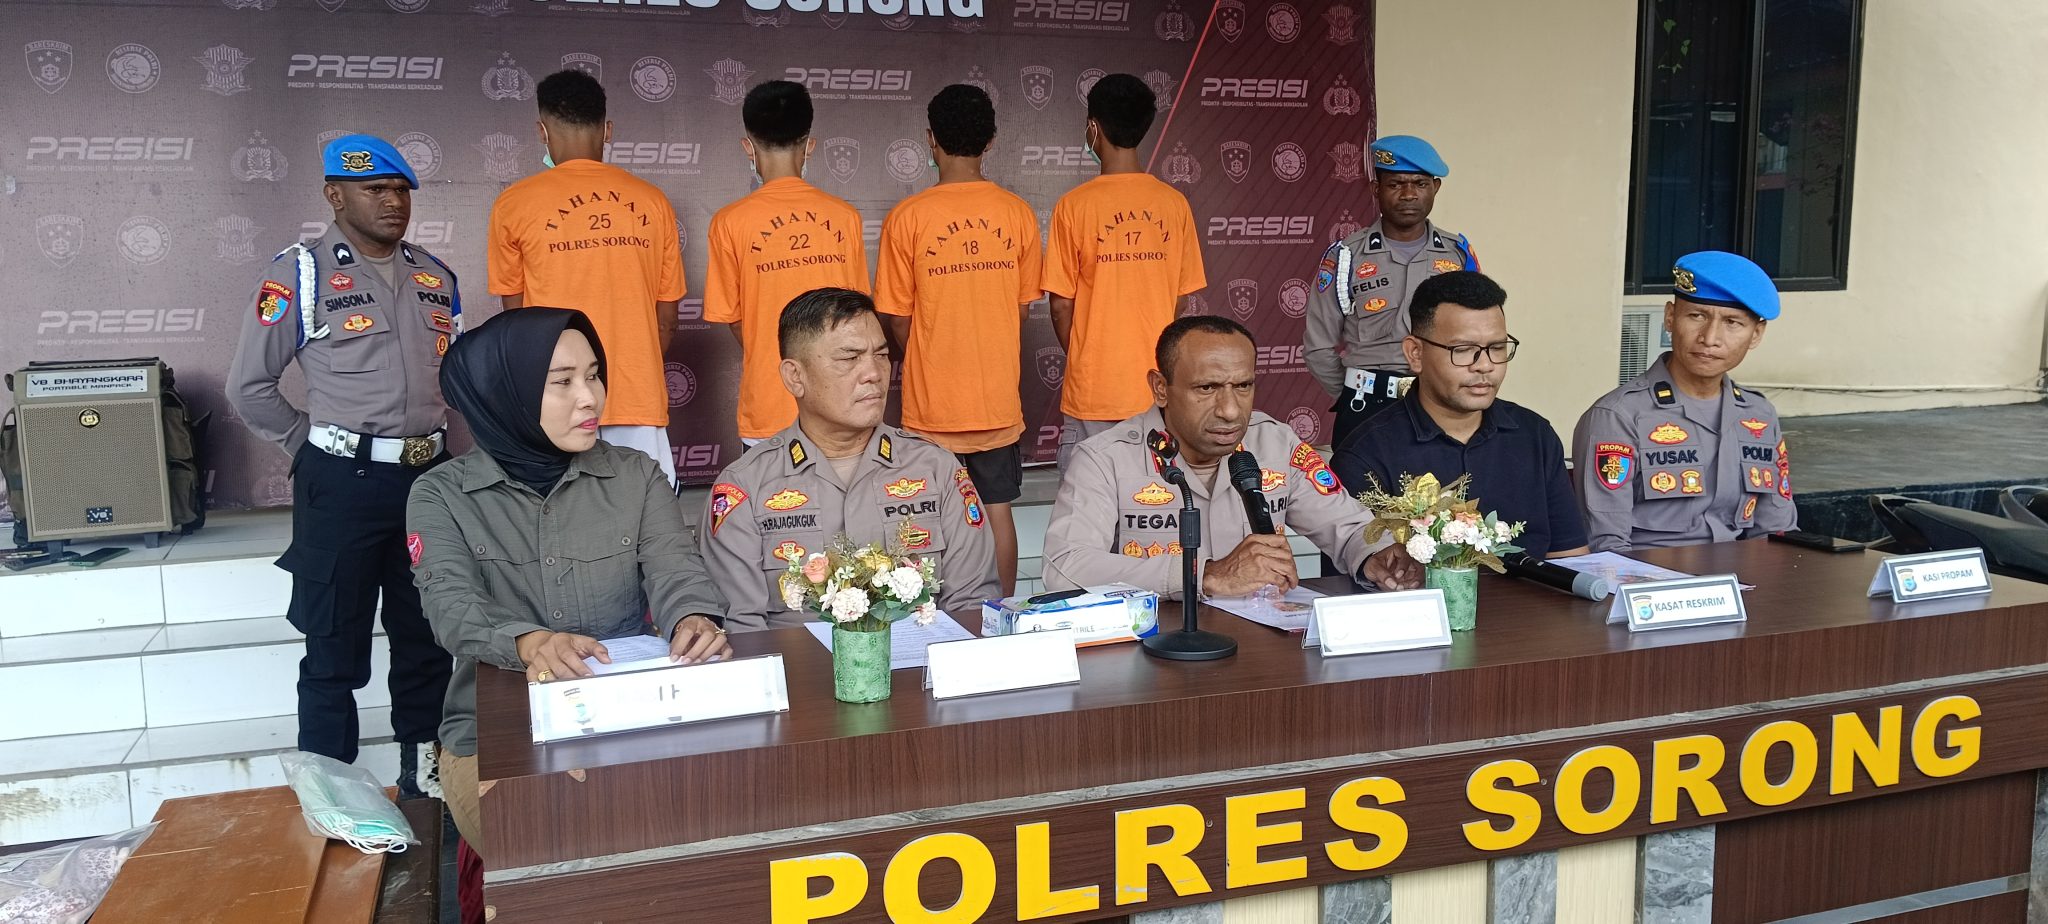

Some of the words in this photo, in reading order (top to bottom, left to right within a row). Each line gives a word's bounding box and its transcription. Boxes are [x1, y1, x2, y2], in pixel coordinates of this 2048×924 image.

[1014, 0, 1129, 22] PRESISI
[288, 54, 444, 80] PRESISI
[1201, 77, 1309, 99] PRESISI
[26, 136, 194, 161] PRESISI
[544, 190, 651, 231] TAHANAN
[588, 213, 611, 230] 25
[1096, 210, 1171, 245] TAHANAN
[1208, 216, 1315, 237] PRESISI
[750, 211, 845, 254] TAHANAN
[925, 218, 1015, 257] TAHANAN
[1124, 231, 1142, 246] 17
[549, 239, 600, 253] POLRES
[602, 235, 650, 249] SORONG
[789, 233, 811, 251] 22
[962, 240, 979, 256] 18
[756, 257, 801, 274] POLRES
[802, 254, 846, 266] SORONG
[928, 262, 971, 277] POLRES
[971, 260, 1015, 271] SORONG
[265, 281, 292, 297] PROPAM
[1352, 277, 1390, 295] FELIS
[325, 293, 376, 312] SIMSON.A
[37, 308, 205, 335] PRESISI
[42, 383, 88, 392] PORTABLE
[54, 375, 144, 385] BHAYANGKARA
[1600, 444, 1630, 453] PROPAM
[1742, 445, 1773, 462] POLRI
[1646, 450, 1699, 466] YUSAK
[884, 501, 937, 518] POLRI
[1923, 574, 1941, 582] KASI
[1941, 569, 1974, 580] PROPAM
[1655, 600, 1684, 612] KASAT
[1686, 597, 1726, 609] RESKRIM
[769, 776, 1409, 924] POLRES
[1462, 694, 1983, 852] SORONG
